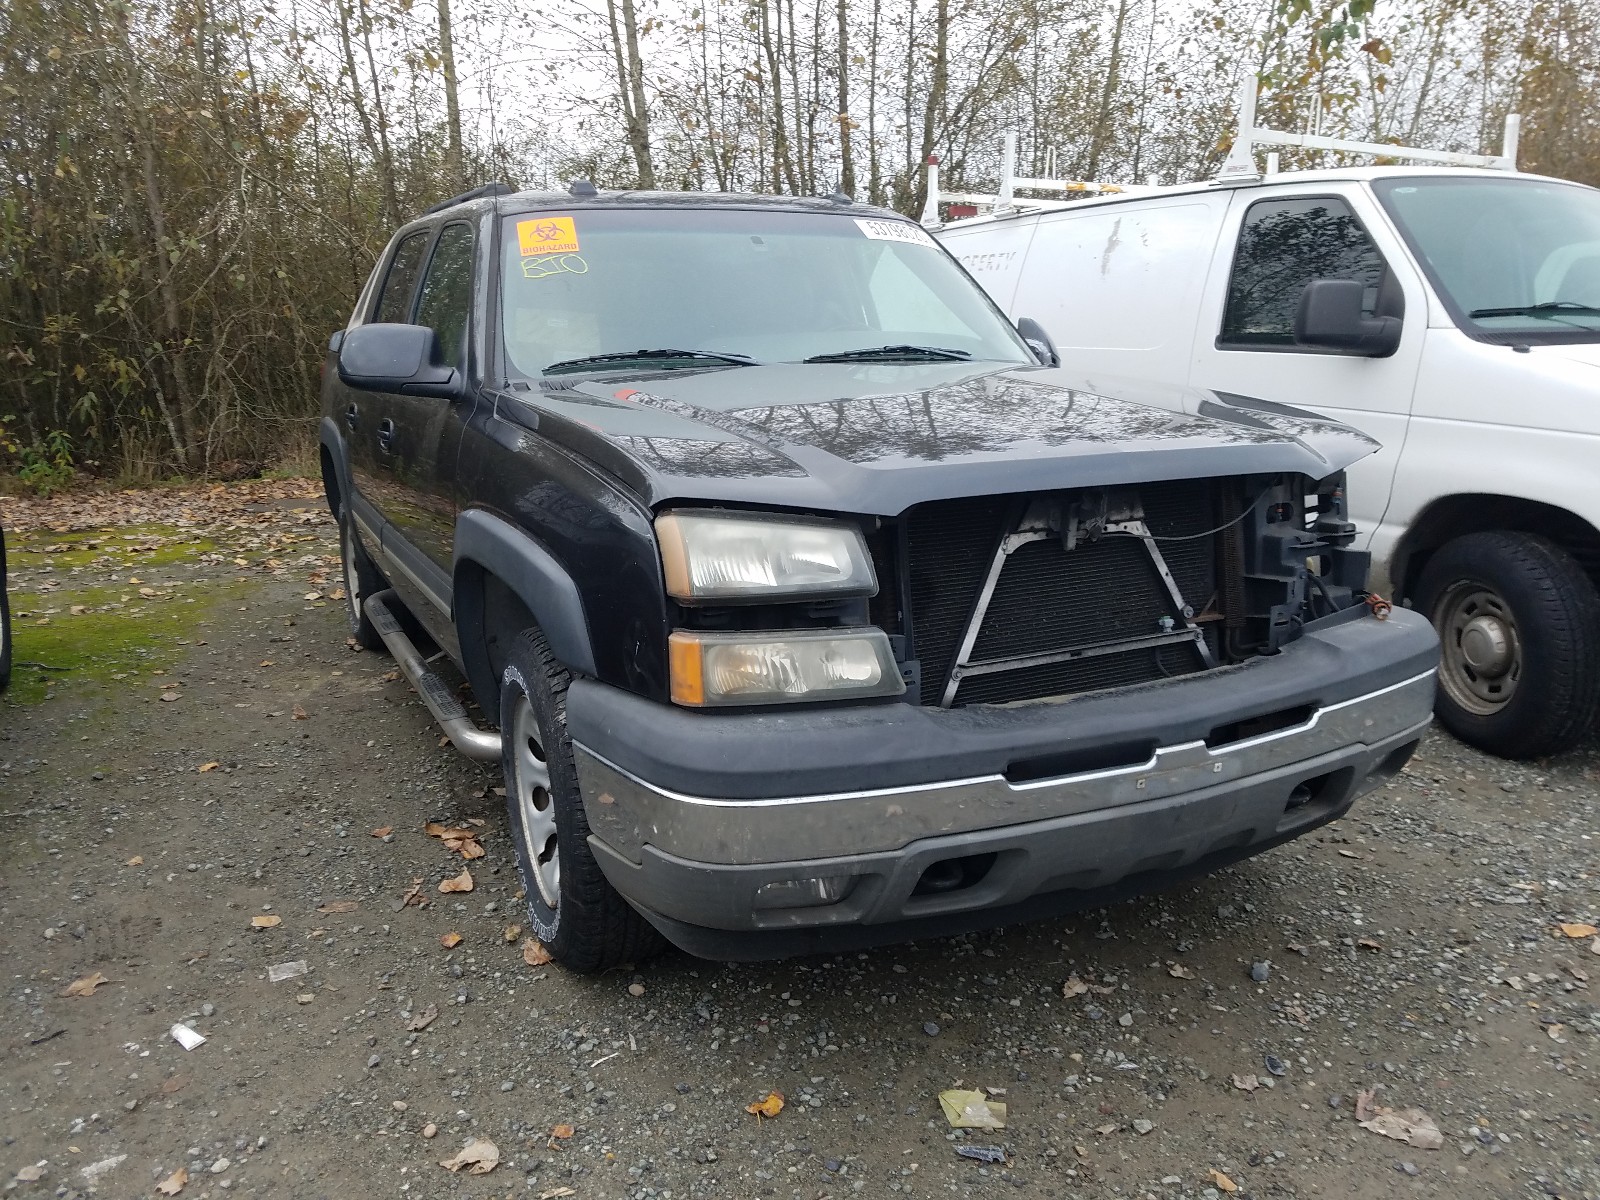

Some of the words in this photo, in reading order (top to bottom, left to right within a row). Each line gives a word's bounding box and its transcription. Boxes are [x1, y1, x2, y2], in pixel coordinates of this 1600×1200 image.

[522, 243, 577, 254] BIOHAZARD
[520, 253, 589, 278] BIO
[956, 251, 1017, 271] OPERTY
